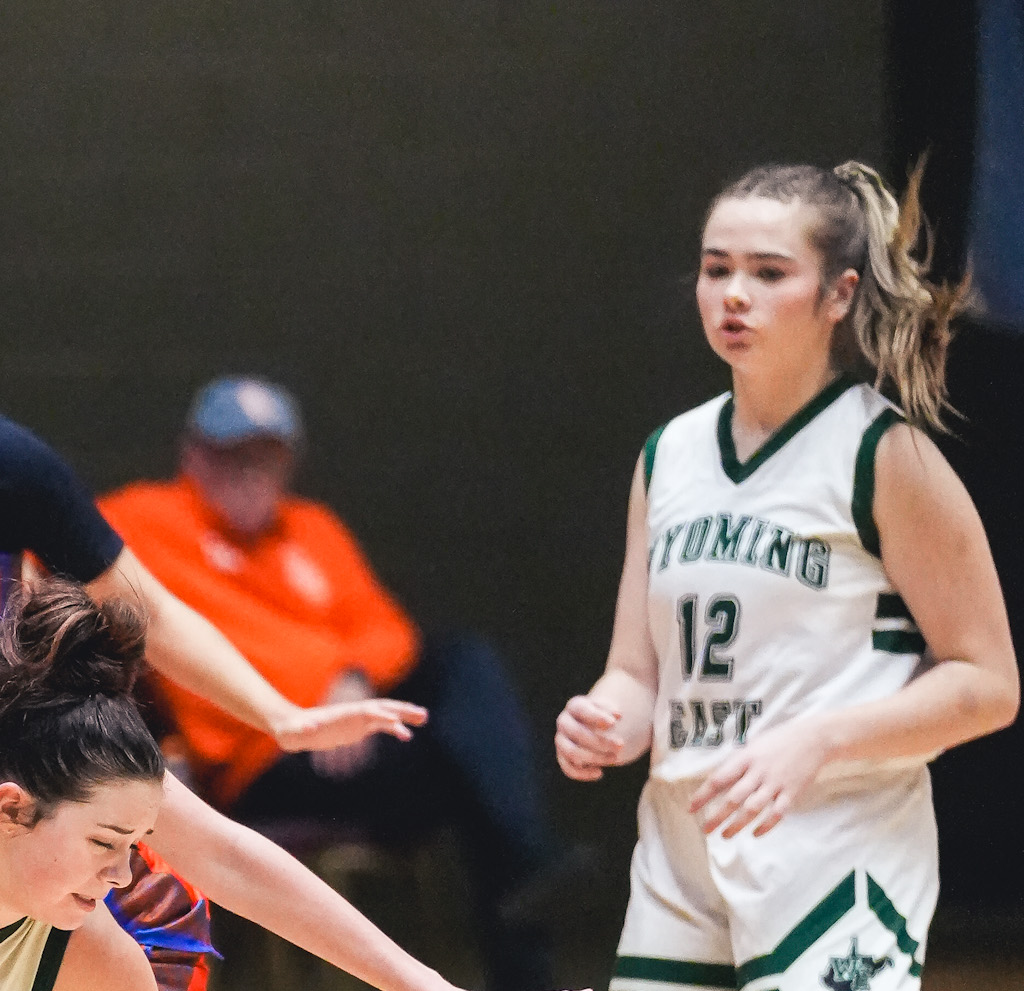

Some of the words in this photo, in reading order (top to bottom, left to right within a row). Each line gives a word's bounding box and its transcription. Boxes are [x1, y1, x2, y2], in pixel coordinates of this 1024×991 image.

[650, 512, 832, 592] YOMING
[677, 592, 741, 684] 12
[668, 699, 763, 750] EAST
